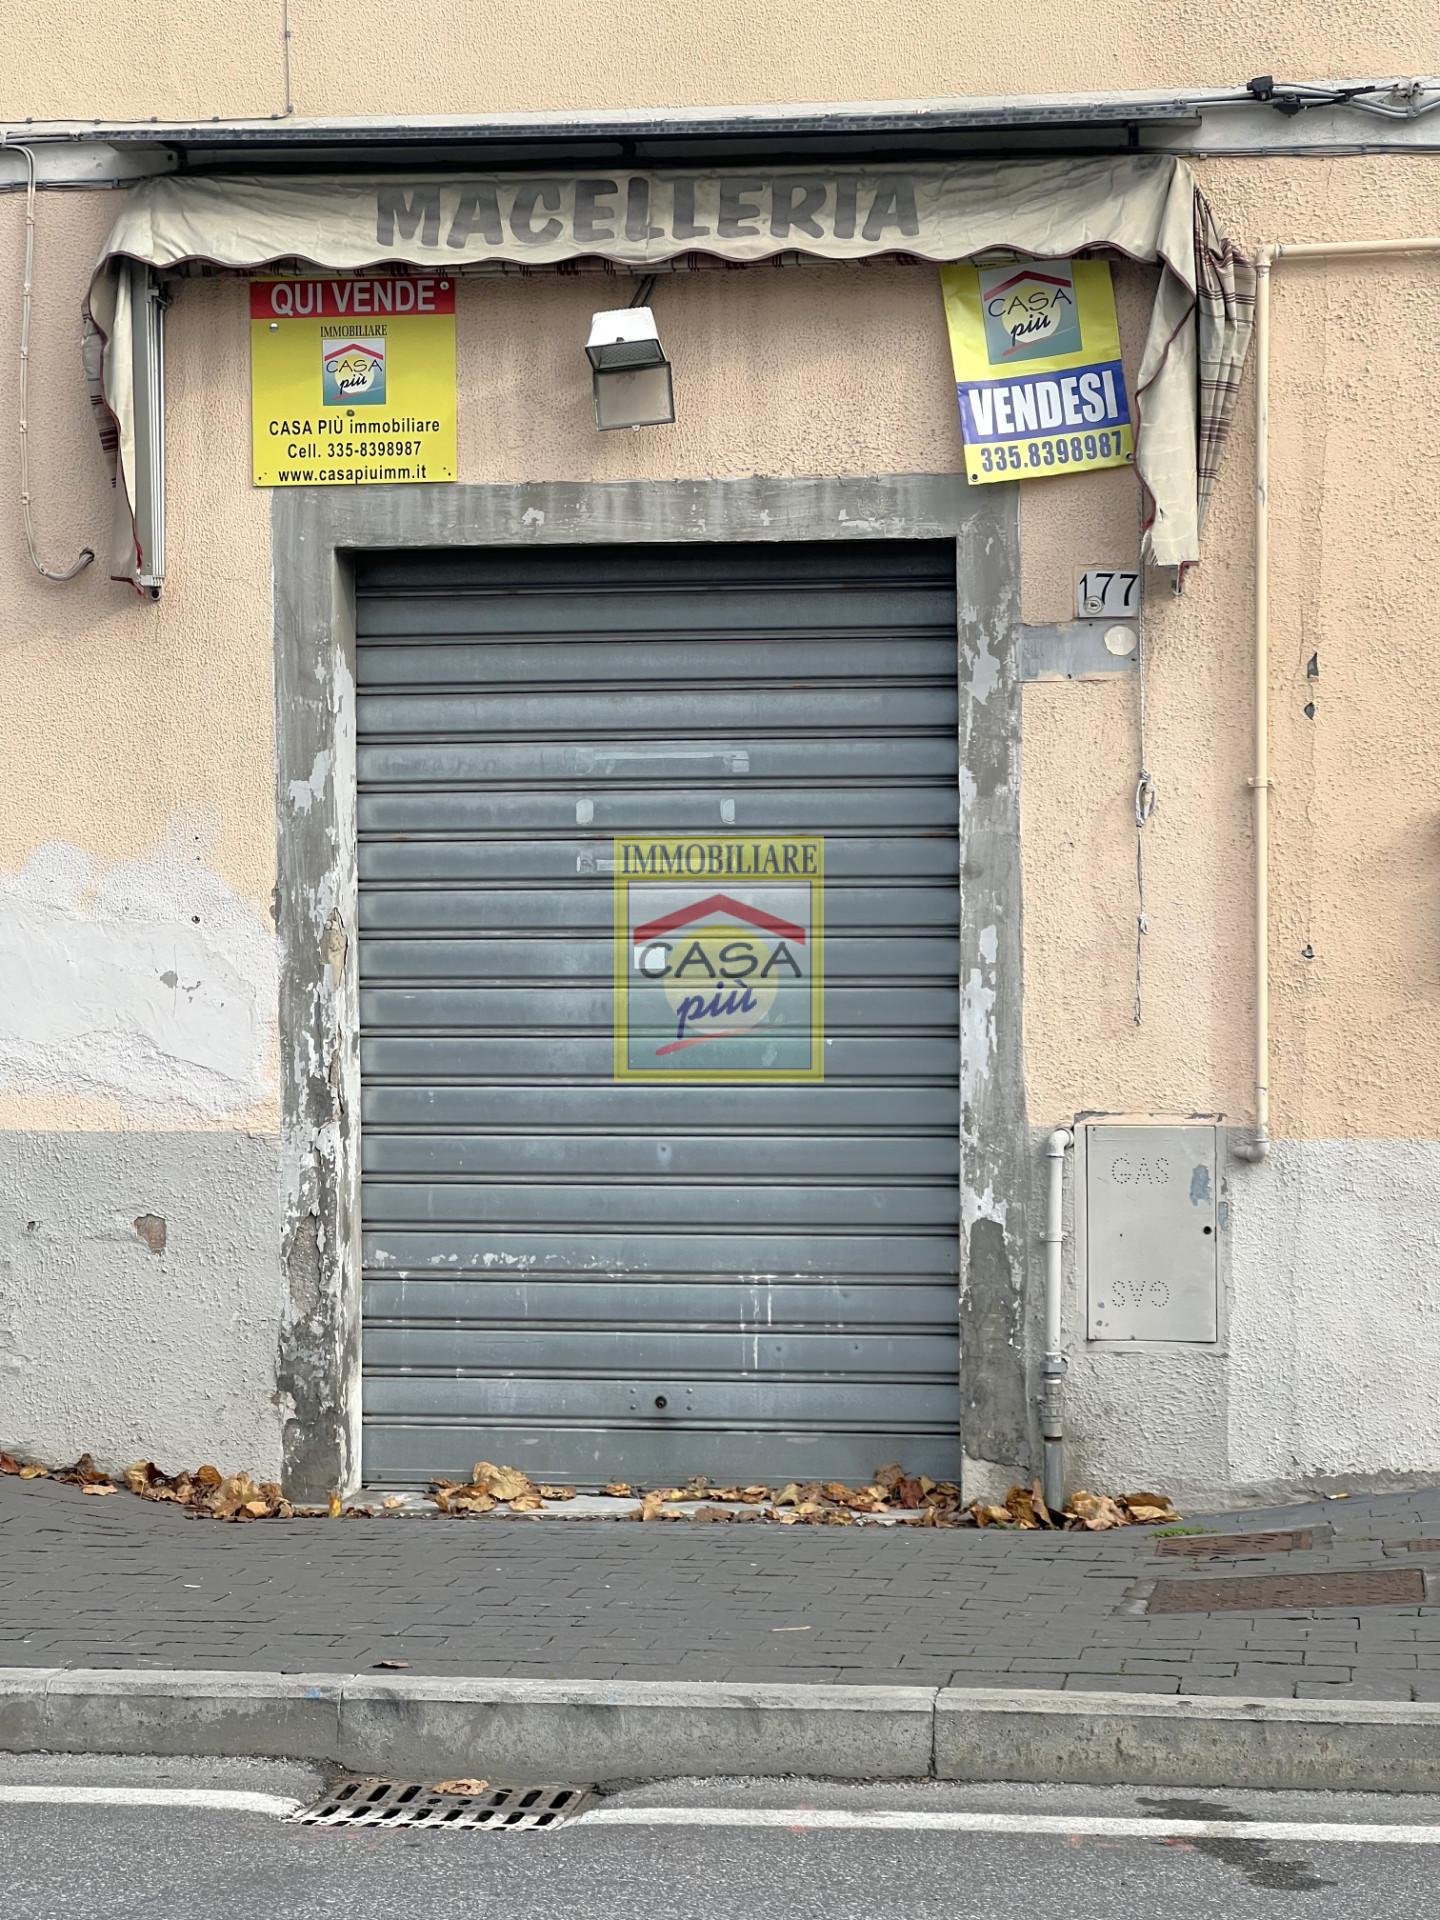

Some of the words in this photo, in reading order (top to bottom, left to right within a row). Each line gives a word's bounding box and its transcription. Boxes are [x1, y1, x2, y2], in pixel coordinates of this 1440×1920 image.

[376, 174, 920, 250] MACELLERIA
[270, 283, 323, 316] QUI
[332, 280, 436, 313] VENDE
[988, 288, 1072, 318] CASA
[320, 324, 388, 338] IMMOBILIARE
[1010, 313, 1051, 347] più
[326, 359, 383, 374] CASA
[339, 373, 368, 396] più
[968, 370, 1118, 436] VENDESI
[269, 420, 312, 436] CASA
[318, 415, 344, 435] PIÙ
[349, 417, 440, 434] immobiliare
[287, 443, 322, 459] Cell.
[327, 441, 422, 458] 335-8398987
[980, 430, 1122, 473] 335.8398987
[278, 465, 427, 485] www.casapiuimm.it
[1079, 572, 1139, 607] 177
[1111, 1157, 1169, 1185] GAS
